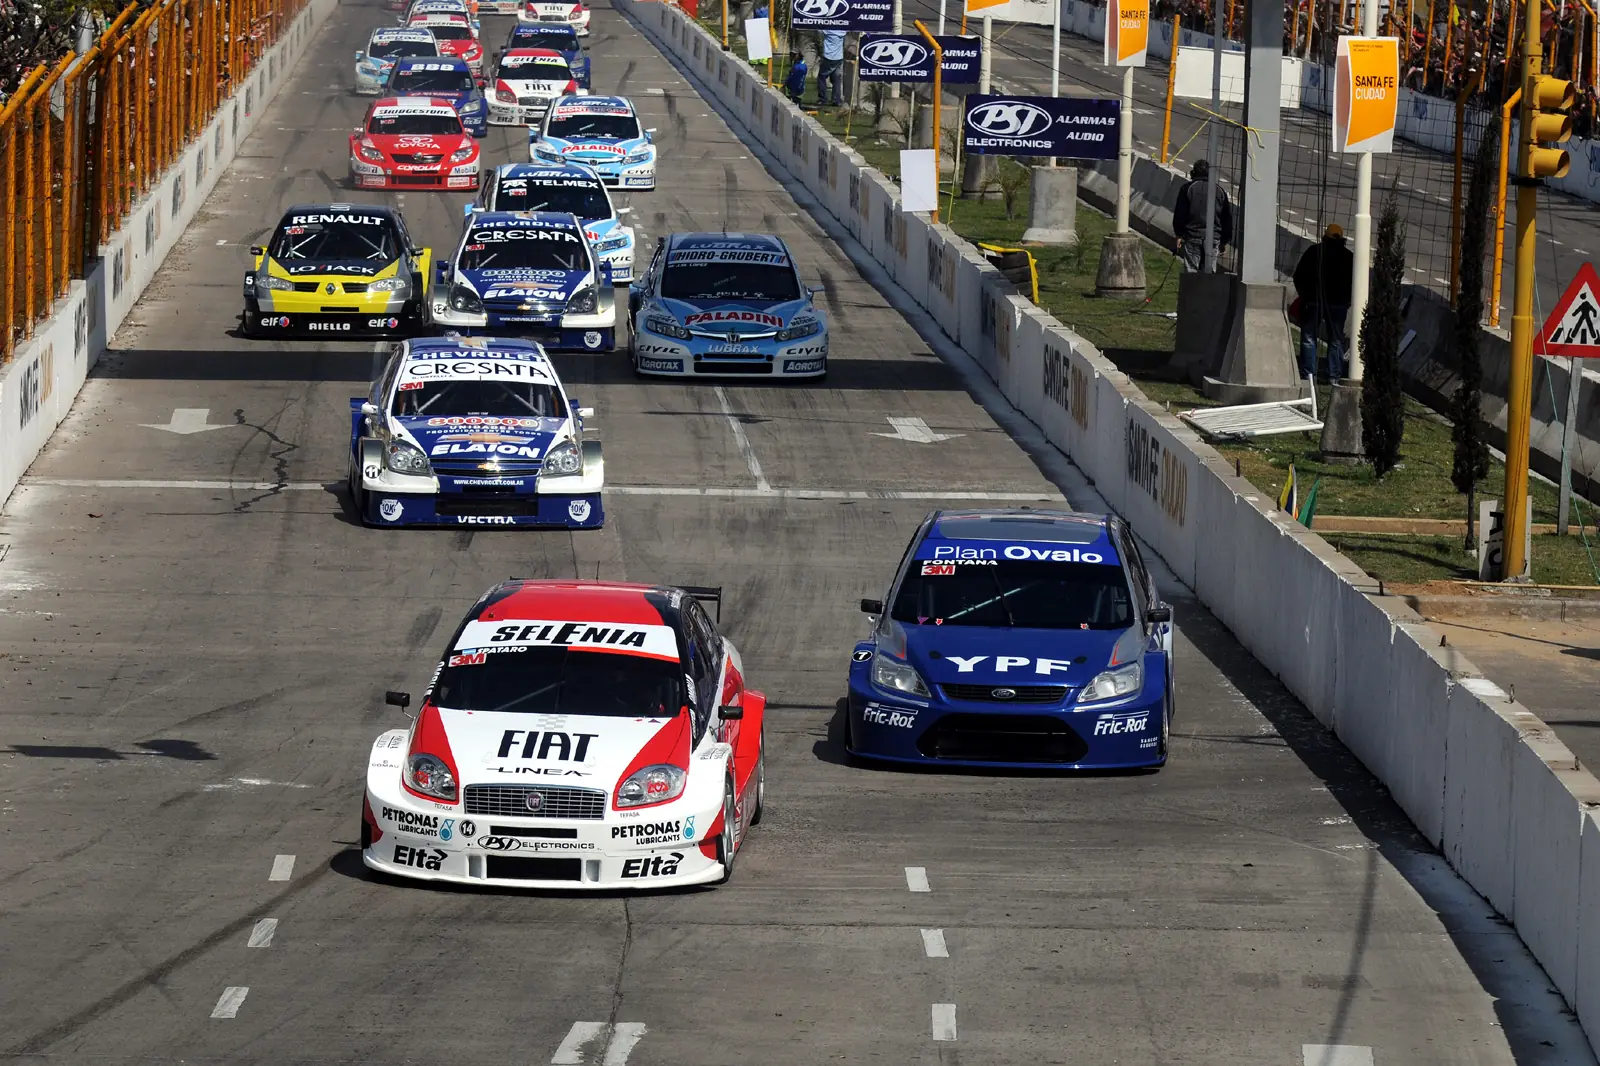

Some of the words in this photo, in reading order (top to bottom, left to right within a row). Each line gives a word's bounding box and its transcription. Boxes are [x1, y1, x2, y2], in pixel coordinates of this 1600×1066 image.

[850, 3, 891, 11] ALARMAS
[1120, 10, 1138, 19] SANTA
[1138, 11, 1146, 19] FE
[793, 18, 849, 26] ELECTRONICS
[1120, 20, 1140, 29] CIUDAD
[930, 49, 977, 58] AARMAS
[860, 68, 927, 77] ELECTRONICS
[525, 83, 553, 91] FIAT
[1355, 76, 1382, 87] SANTA
[1383, 77, 1394, 87] FE
[1355, 88, 1386, 100] CIUDAD
[1055, 115, 1116, 126] ALARMAS
[1066, 131, 1105, 142] AUDIO
[966, 137, 1052, 149] ELECTRONICS
[561, 145, 627, 155] PALADINI
[397, 163, 442, 171] COROLLA
[454, 166, 471, 174] Mobil
[519, 171, 583, 179] LUBRAX
[532, 180, 600, 189] TELMEX
[292, 214, 385, 226] RENAULT
[472, 221, 576, 230] CHEVROLET
[474, 230, 579, 243] CRESATA
[676, 251, 775, 263] HIDRO-GRUBERT
[246, 276, 253, 285] 5
[483, 289, 567, 301] ELAION
[434, 305, 444, 313] 12
[261, 317, 279, 327] elf
[368, 318, 387, 328] elf
[684, 312, 784, 328] PALADINI
[309, 322, 351, 331] AIELLO
[639, 344, 681, 355] CIVIC
[708, 343, 760, 354] LUBRAX
[407, 351, 545, 362] CHEVROLET
[641, 358, 680, 371] AGROTAX
[409, 362, 549, 379] CRESATA
[400, 381, 424, 391] 3M
[428, 417, 539, 428] 800000
[431, 444, 541, 459] ELAION
[365, 466, 379, 478] 11
[457, 515, 517, 524] VECTRA
[934, 544, 997, 560] Plan
[1004, 546, 1103, 564] Ovalo
[923, 565, 954, 576] 3M
[490, 623, 649, 648] SELENIA
[475, 646, 528, 656] SPATARO
[858, 651, 867, 660] 7
[452, 654, 486, 668] 3M
[945, 655, 1071, 676] YPF
[863, 707, 916, 730] Fric-Rot
[1094, 718, 1148, 736] Fric-Rot
[497, 730, 599, 764] FIAT
[498, 767, 584, 777] LINEA
[382, 806, 439, 831] PETRONAS
[397, 822, 438, 837] LUBRICANTS
[461, 821, 475, 836] 14
[611, 820, 681, 839] PETRONAS
[636, 834, 681, 845] LUBRICANTS
[522, 841, 595, 850] ELECTRONICS
[393, 845, 444, 872] Elta
[620, 855, 679, 879] Elta
